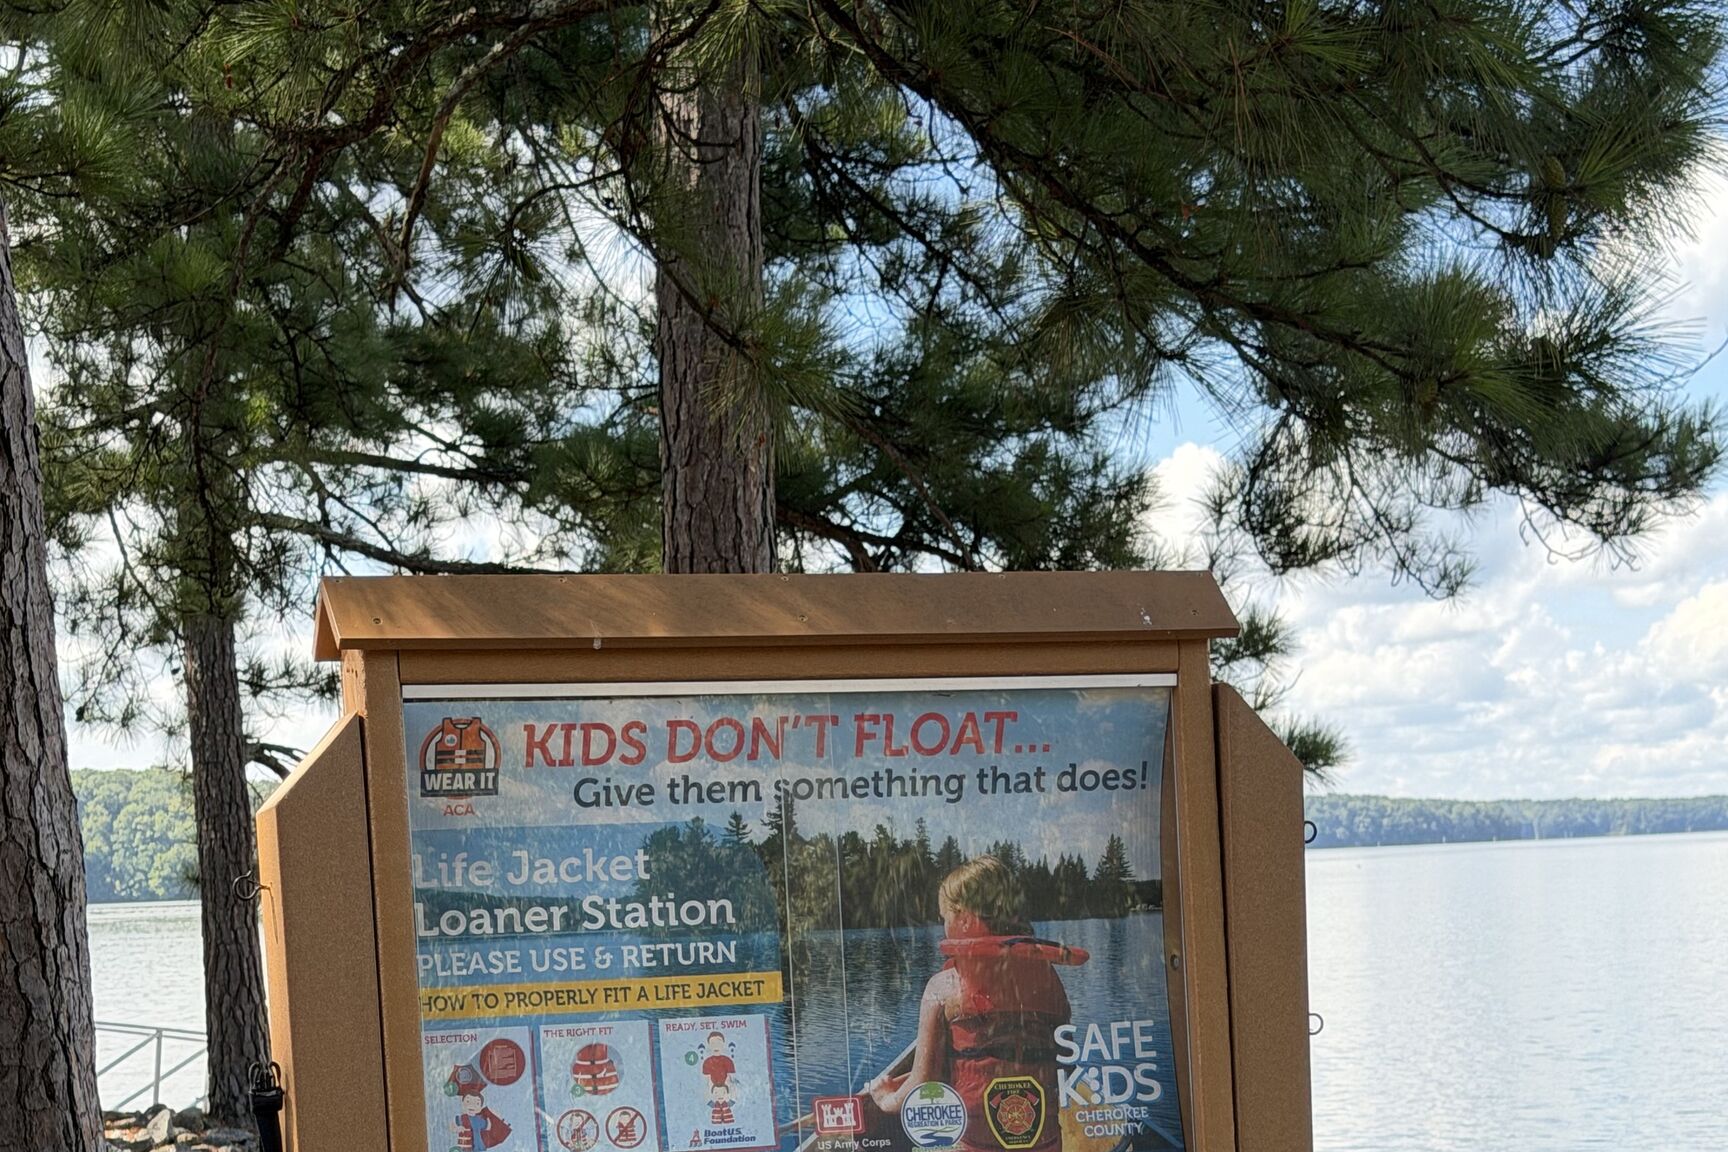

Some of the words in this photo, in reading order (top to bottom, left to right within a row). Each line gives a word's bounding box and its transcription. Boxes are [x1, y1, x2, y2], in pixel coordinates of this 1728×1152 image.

[523, 720, 648, 768] KIDS
[666, 714, 839, 764] DON'T
[854, 711, 1050, 758] FLOAT...
[424, 772, 475, 790] WEAR
[480, 772, 495, 789] IT
[573, 777, 655, 808] Give
[667, 775, 762, 804] them
[774, 768, 965, 803] something
[976, 766, 1046, 794] that
[1057, 761, 1147, 792] does!
[443, 803, 475, 816] ACA
[413, 852, 493, 888] Life
[507, 848, 650, 885] Jacket
[414, 903, 568, 936] Loaner
[582, 892, 736, 930] Station
[416, 950, 522, 977] PLEASE
[529, 948, 585, 972] USE
[595, 946, 613, 969] &
[621, 941, 737, 968] RETURN
[420, 994, 467, 1012] HOW
[472, 993, 499, 1009] TO
[504, 988, 598, 1008] PROPERLY
[603, 986, 631, 1003] FIT
[637, 986, 650, 1001] A
[654, 983, 691, 1001] LIFE
[696, 980, 764, 998] JACKET
[721, 1019, 747, 1028] SWIM
[424, 1033, 478, 1045] SELECTION
[544, 1029, 564, 1038] THE
[566, 1028, 596, 1037] RIGHT
[598, 1027, 614, 1035] FIT
[1054, 1020, 1156, 1064] SAFE
[906, 1105, 962, 1121] CHEROKEE
[1076, 1106, 1149, 1122] CHEROKEE
[1084, 1122, 1143, 1137] COUNTY
[704, 1134, 756, 1145] Foundation
[817, 1141, 832, 1150] US
[834, 1140, 859, 1150] Army
[862, 1138, 891, 1148] Corps
